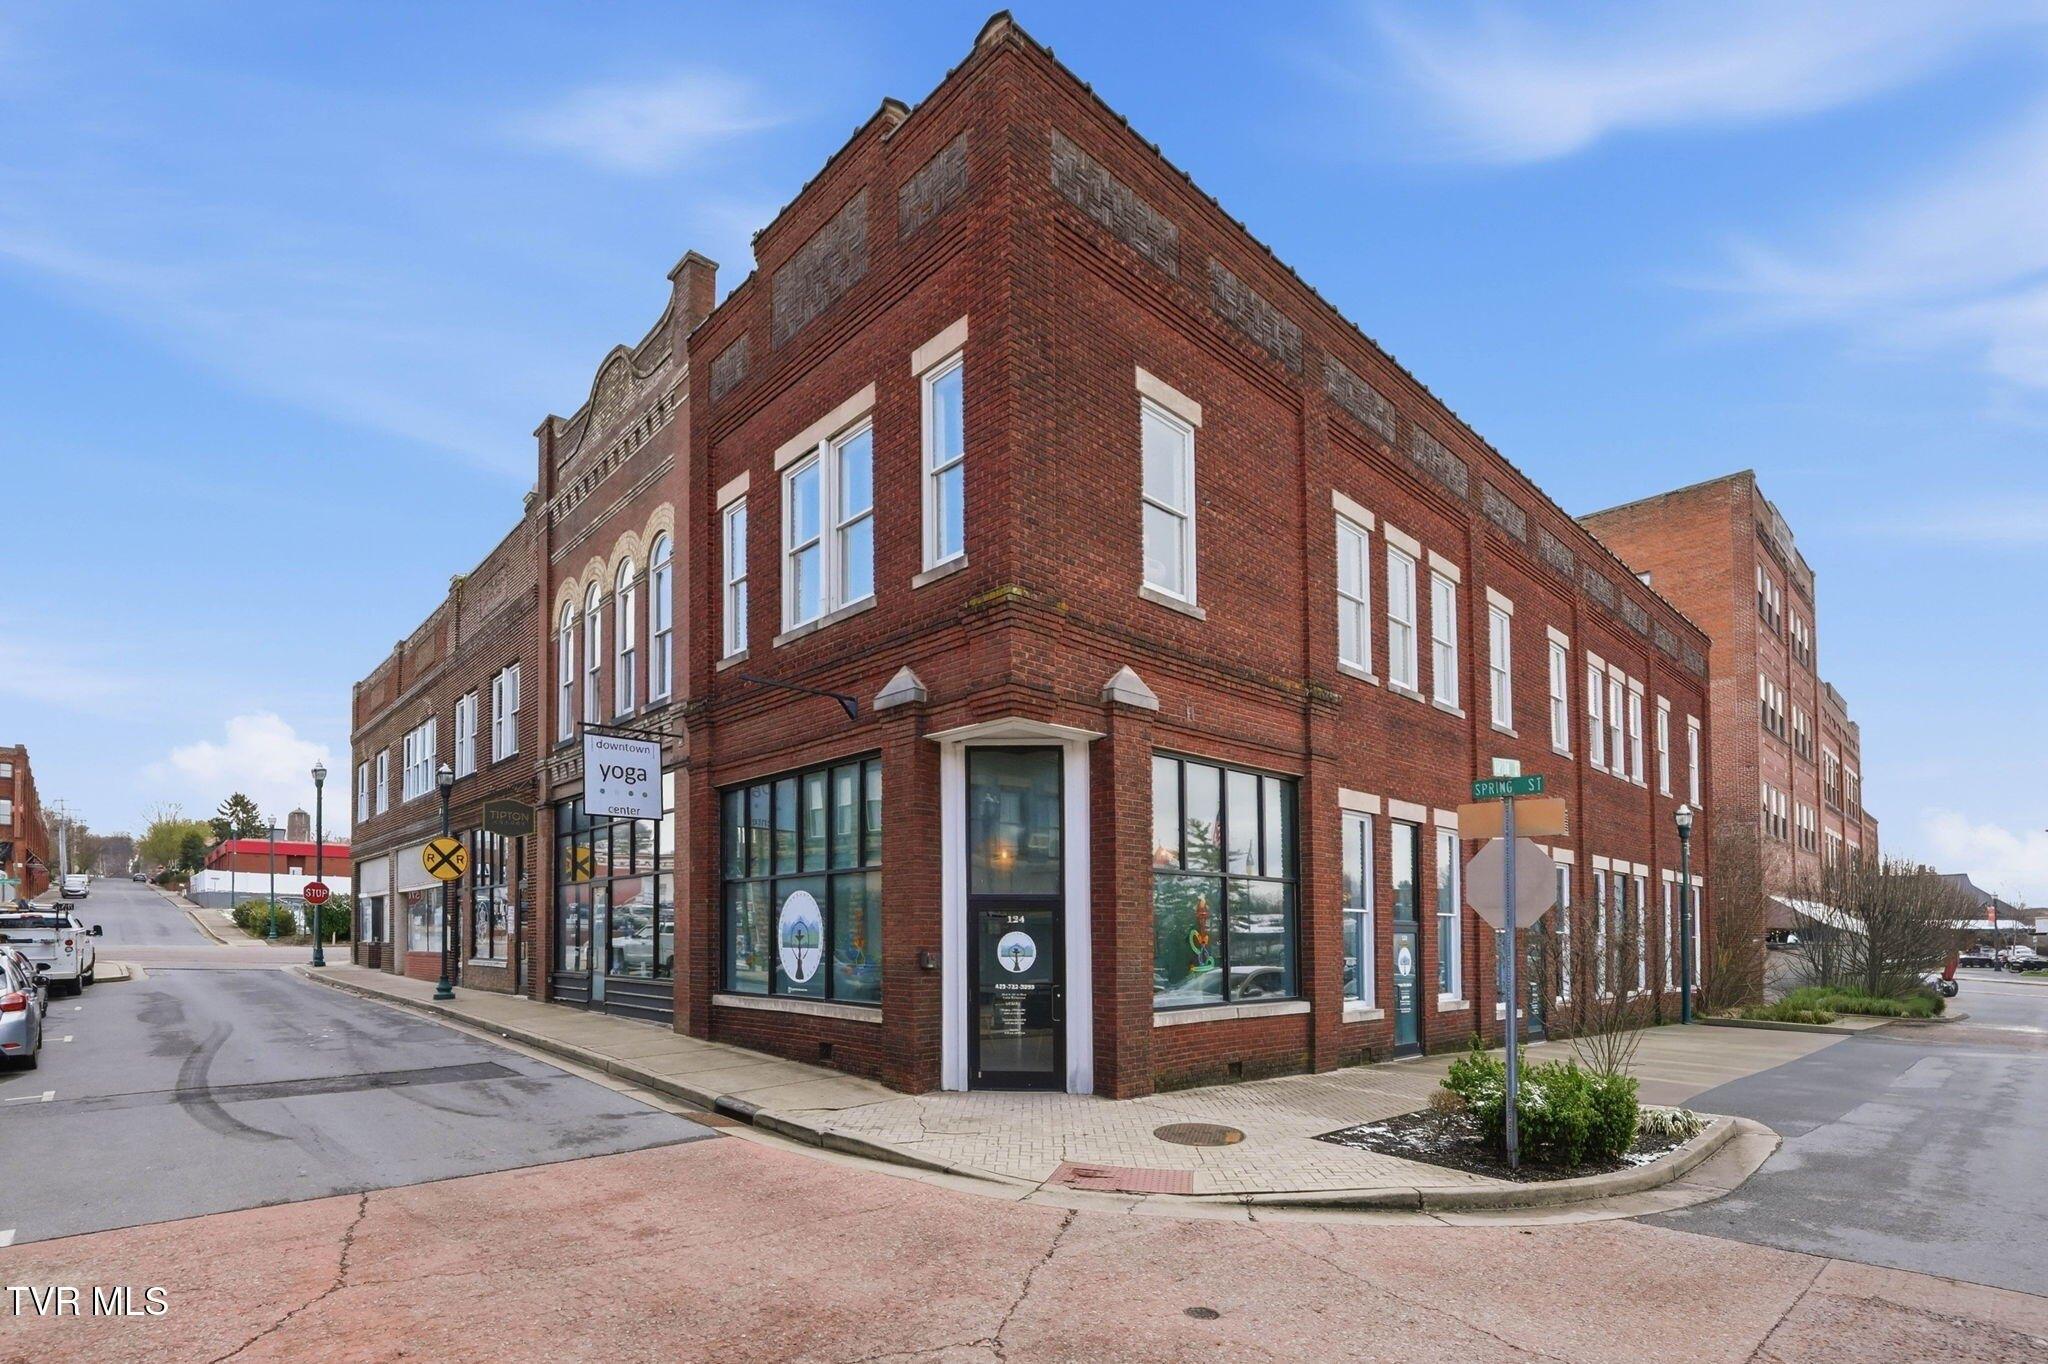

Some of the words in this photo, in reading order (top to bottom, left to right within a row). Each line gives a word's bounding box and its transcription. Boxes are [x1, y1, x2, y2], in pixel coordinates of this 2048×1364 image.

[596, 740, 651, 754] downtown
[599, 763, 647, 784] yoga
[1475, 780, 1513, 796] SPRING
[1528, 777, 1541, 791] ST
[489, 810, 529, 821] TIPTON
[608, 805, 641, 815] center
[427, 853, 434, 863] R
[456, 854, 464, 864] R
[305, 888, 328, 898] STOP
[1007, 915, 1025, 923] 124
